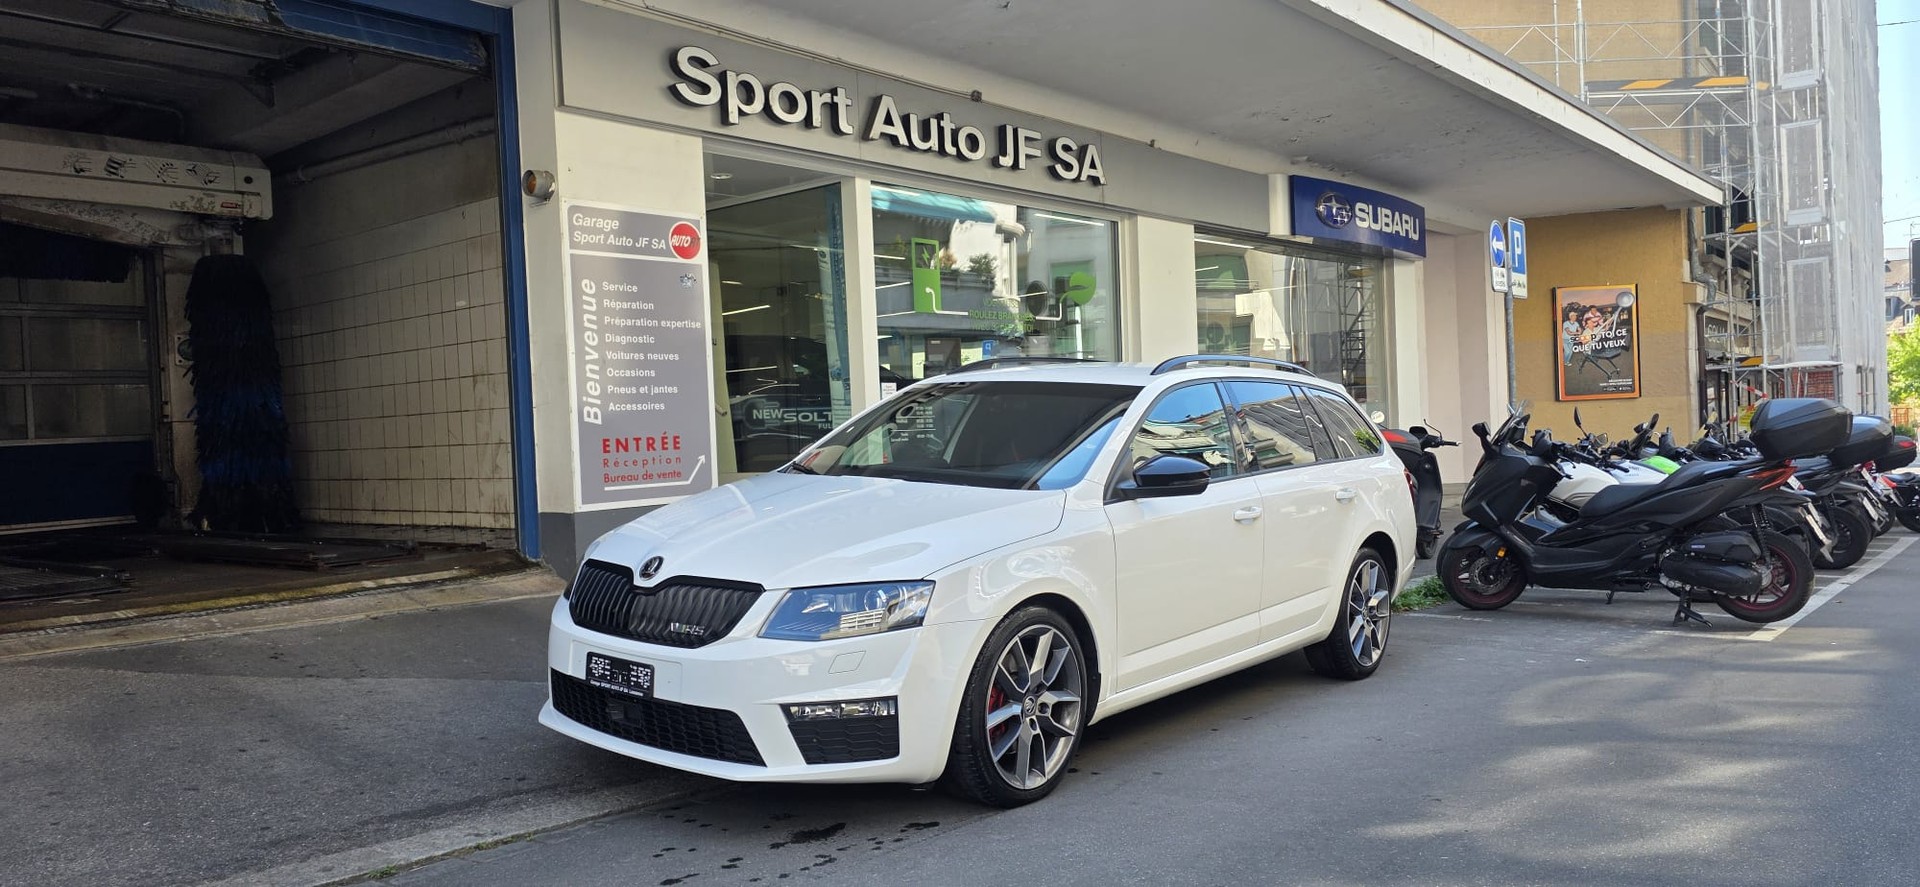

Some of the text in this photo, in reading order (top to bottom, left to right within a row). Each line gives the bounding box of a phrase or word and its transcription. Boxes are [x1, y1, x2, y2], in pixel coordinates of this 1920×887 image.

[669, 45, 1107, 186] Sport Auto JF SA
[572, 213, 620, 232] Garage
[1354, 202, 1420, 241] SUBARU
[573, 231, 667, 250] Sport Auto JF SA
[1513, 230, 1522, 268] P
[602, 281, 639, 293] Service
[603, 299, 654, 311] Réparation
[604, 316, 701, 330] Préparation expertise
[605, 333, 655, 346] Diagnostic
[1615, 328, 1627, 337] CE
[581, 278, 603, 425] Bienvenue
[1572, 338, 1626, 353] QUE TU VEUX
[606, 351, 680, 361] Voitures neuves
[606, 368, 656, 378] Occasions
[607, 385, 679, 396] Pneus et jantes
[608, 402, 666, 412] Accessoires
[752, 408, 783, 420] NEW
[602, 431, 681, 454] ENTRÉE
[602, 455, 682, 469] Réception
[603, 470, 683, 484] Bureau de vente
